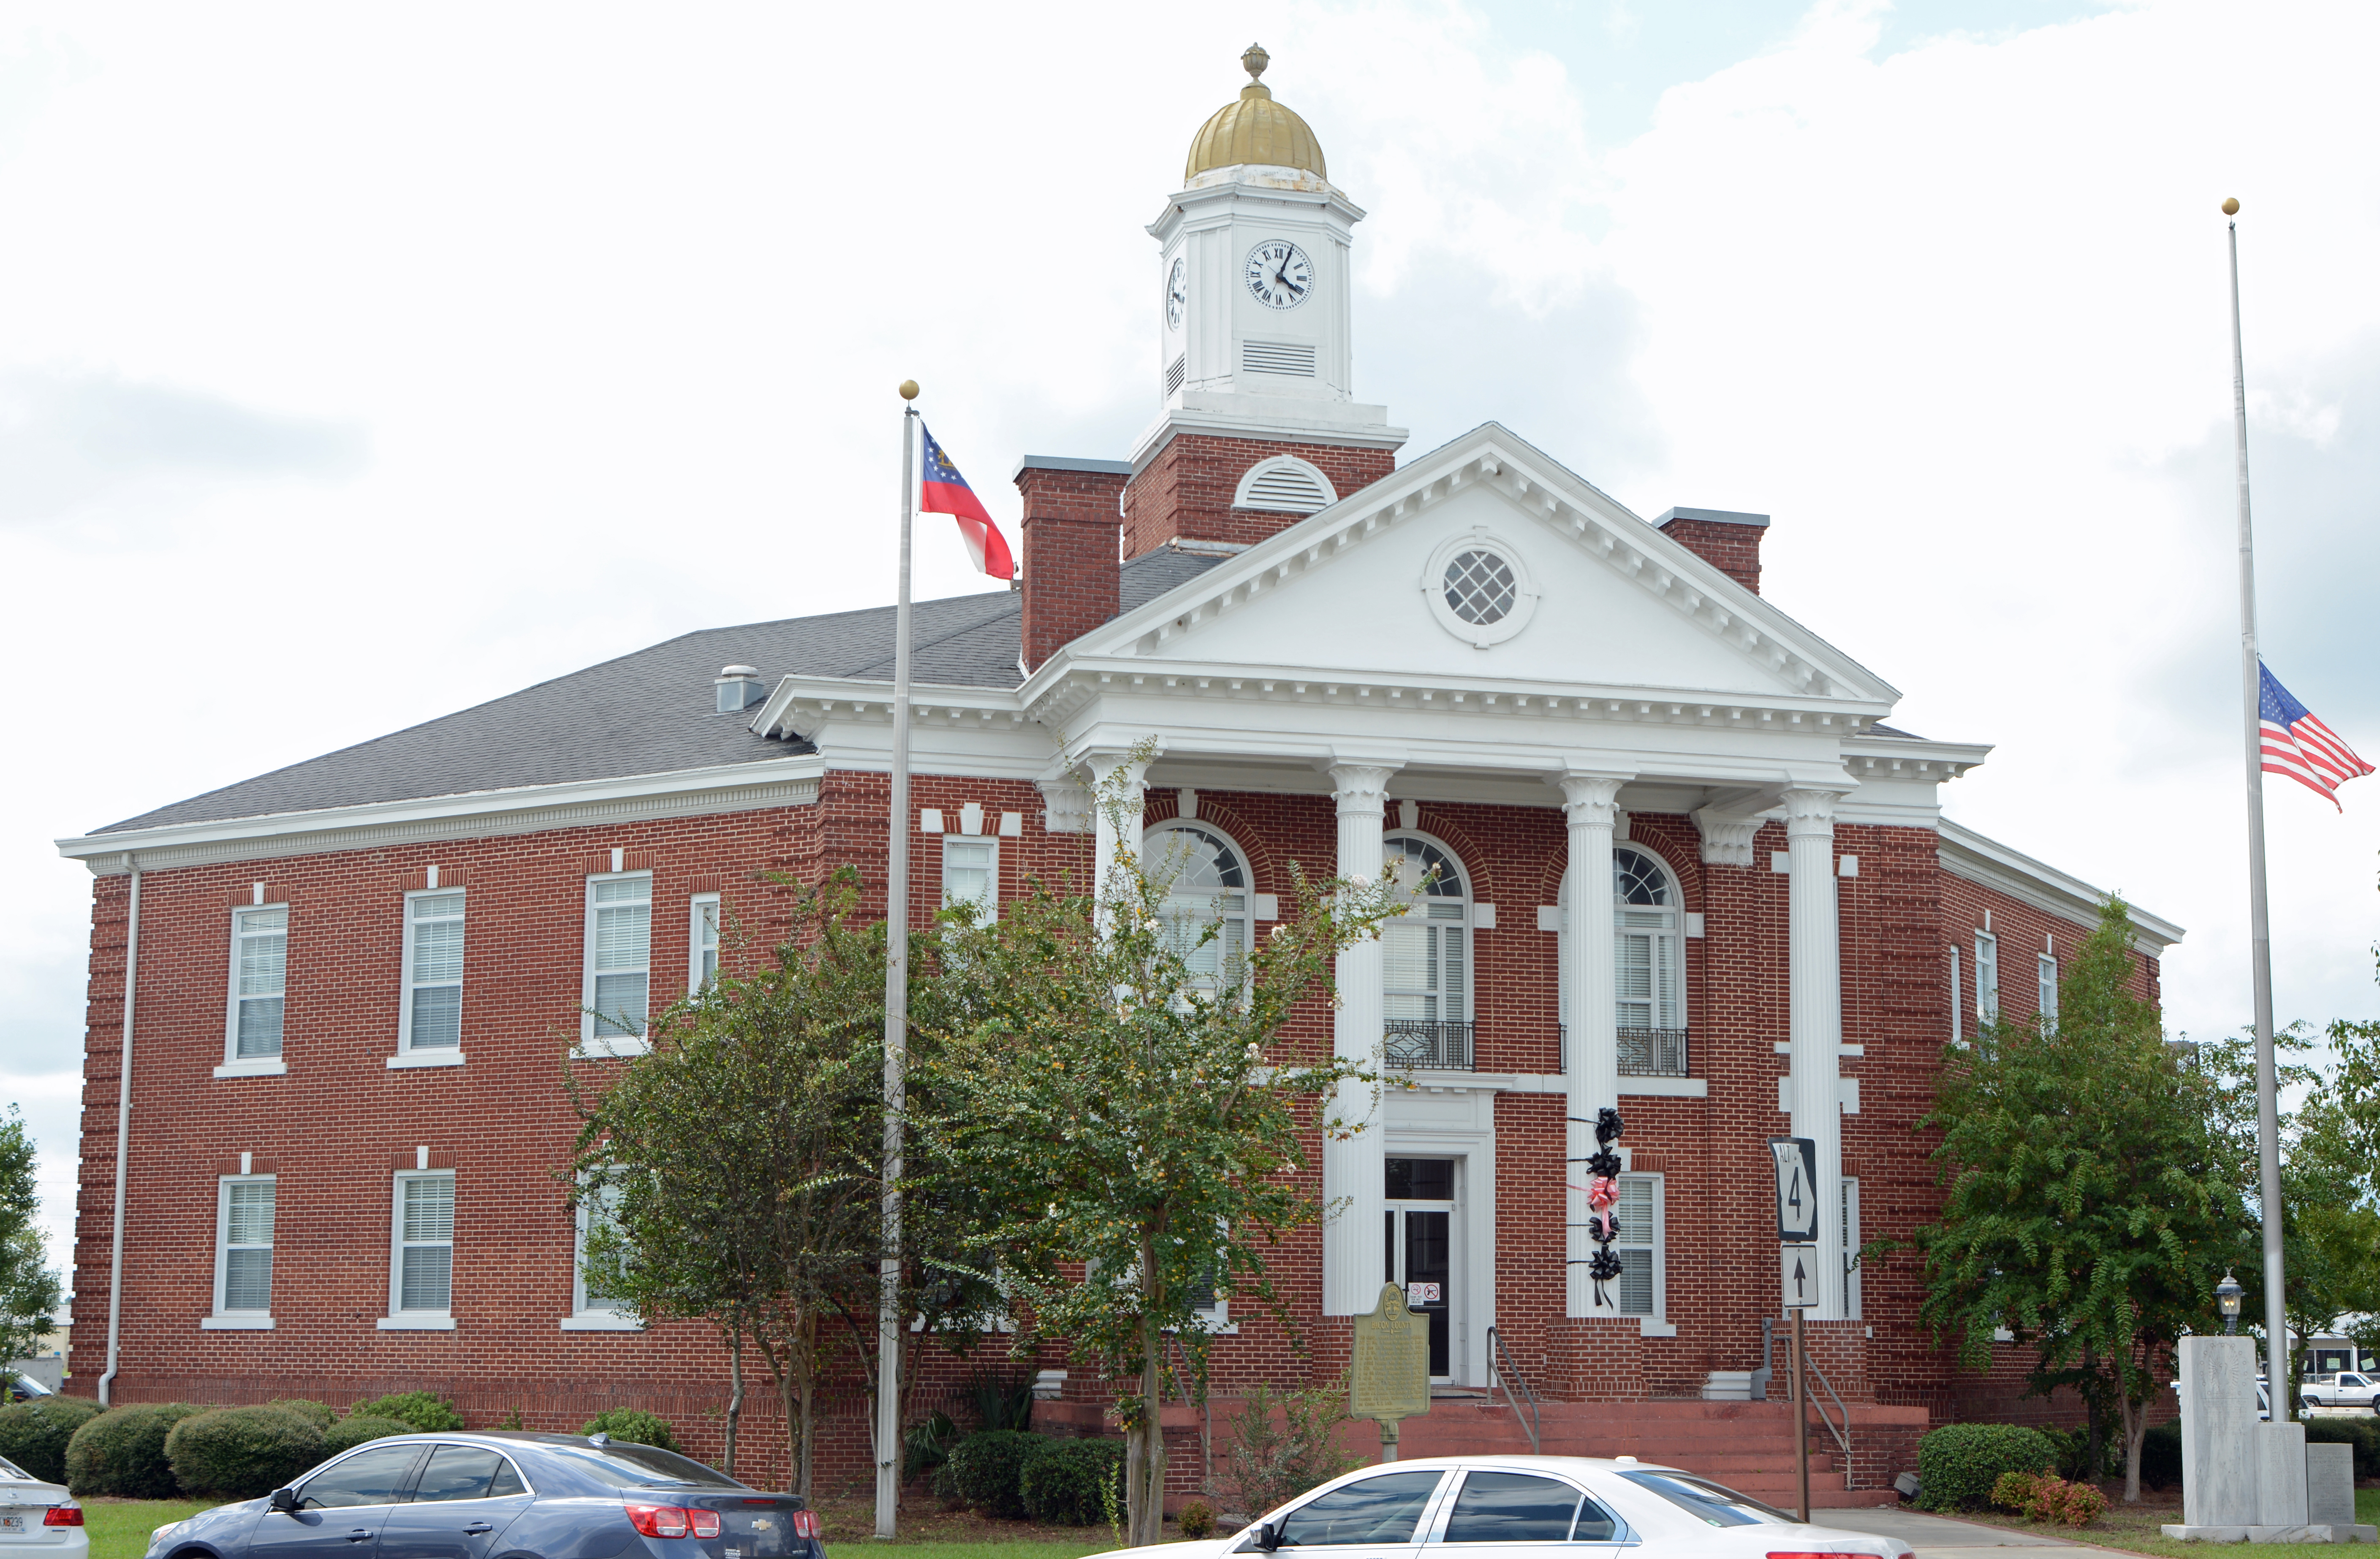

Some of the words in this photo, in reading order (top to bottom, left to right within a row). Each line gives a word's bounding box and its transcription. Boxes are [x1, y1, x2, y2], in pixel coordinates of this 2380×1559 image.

[1262, 250, 1272, 262] XI
[1274, 248, 1283, 259] XII
[1252, 260, 1263, 268] X
[1276, 294, 1283, 305] VI
[1288, 292, 1296, 303] V
[1779, 1145, 1789, 1163] ALT
[1788, 1166, 1801, 1221] 4
[1372, 1321, 1389, 1329] BACON
